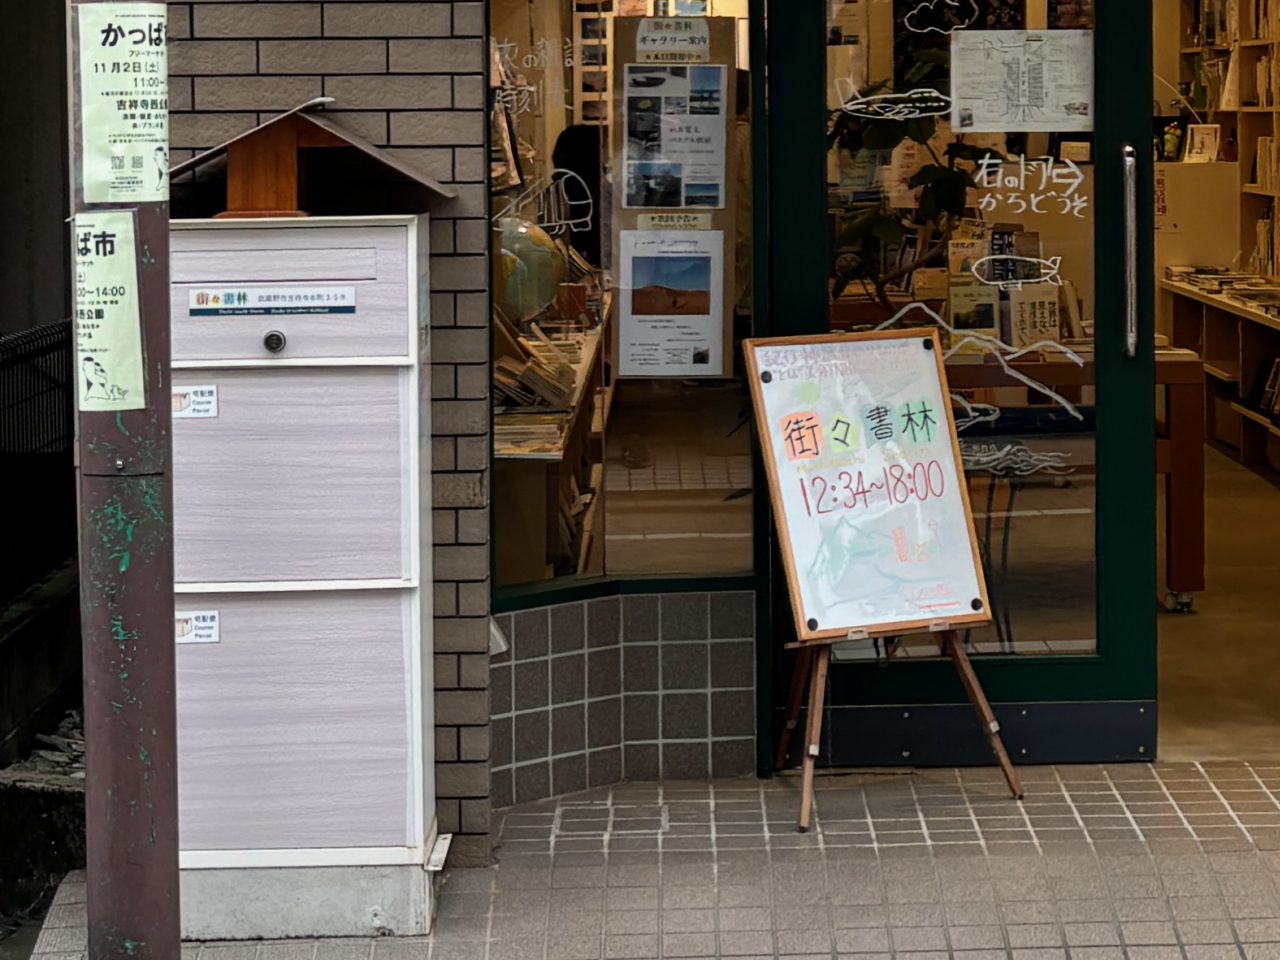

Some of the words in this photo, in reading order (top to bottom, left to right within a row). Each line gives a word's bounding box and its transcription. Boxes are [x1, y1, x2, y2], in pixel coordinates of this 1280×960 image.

[100, 22, 168, 47] かっぱ
[783, 400, 937, 457] 街々書林
